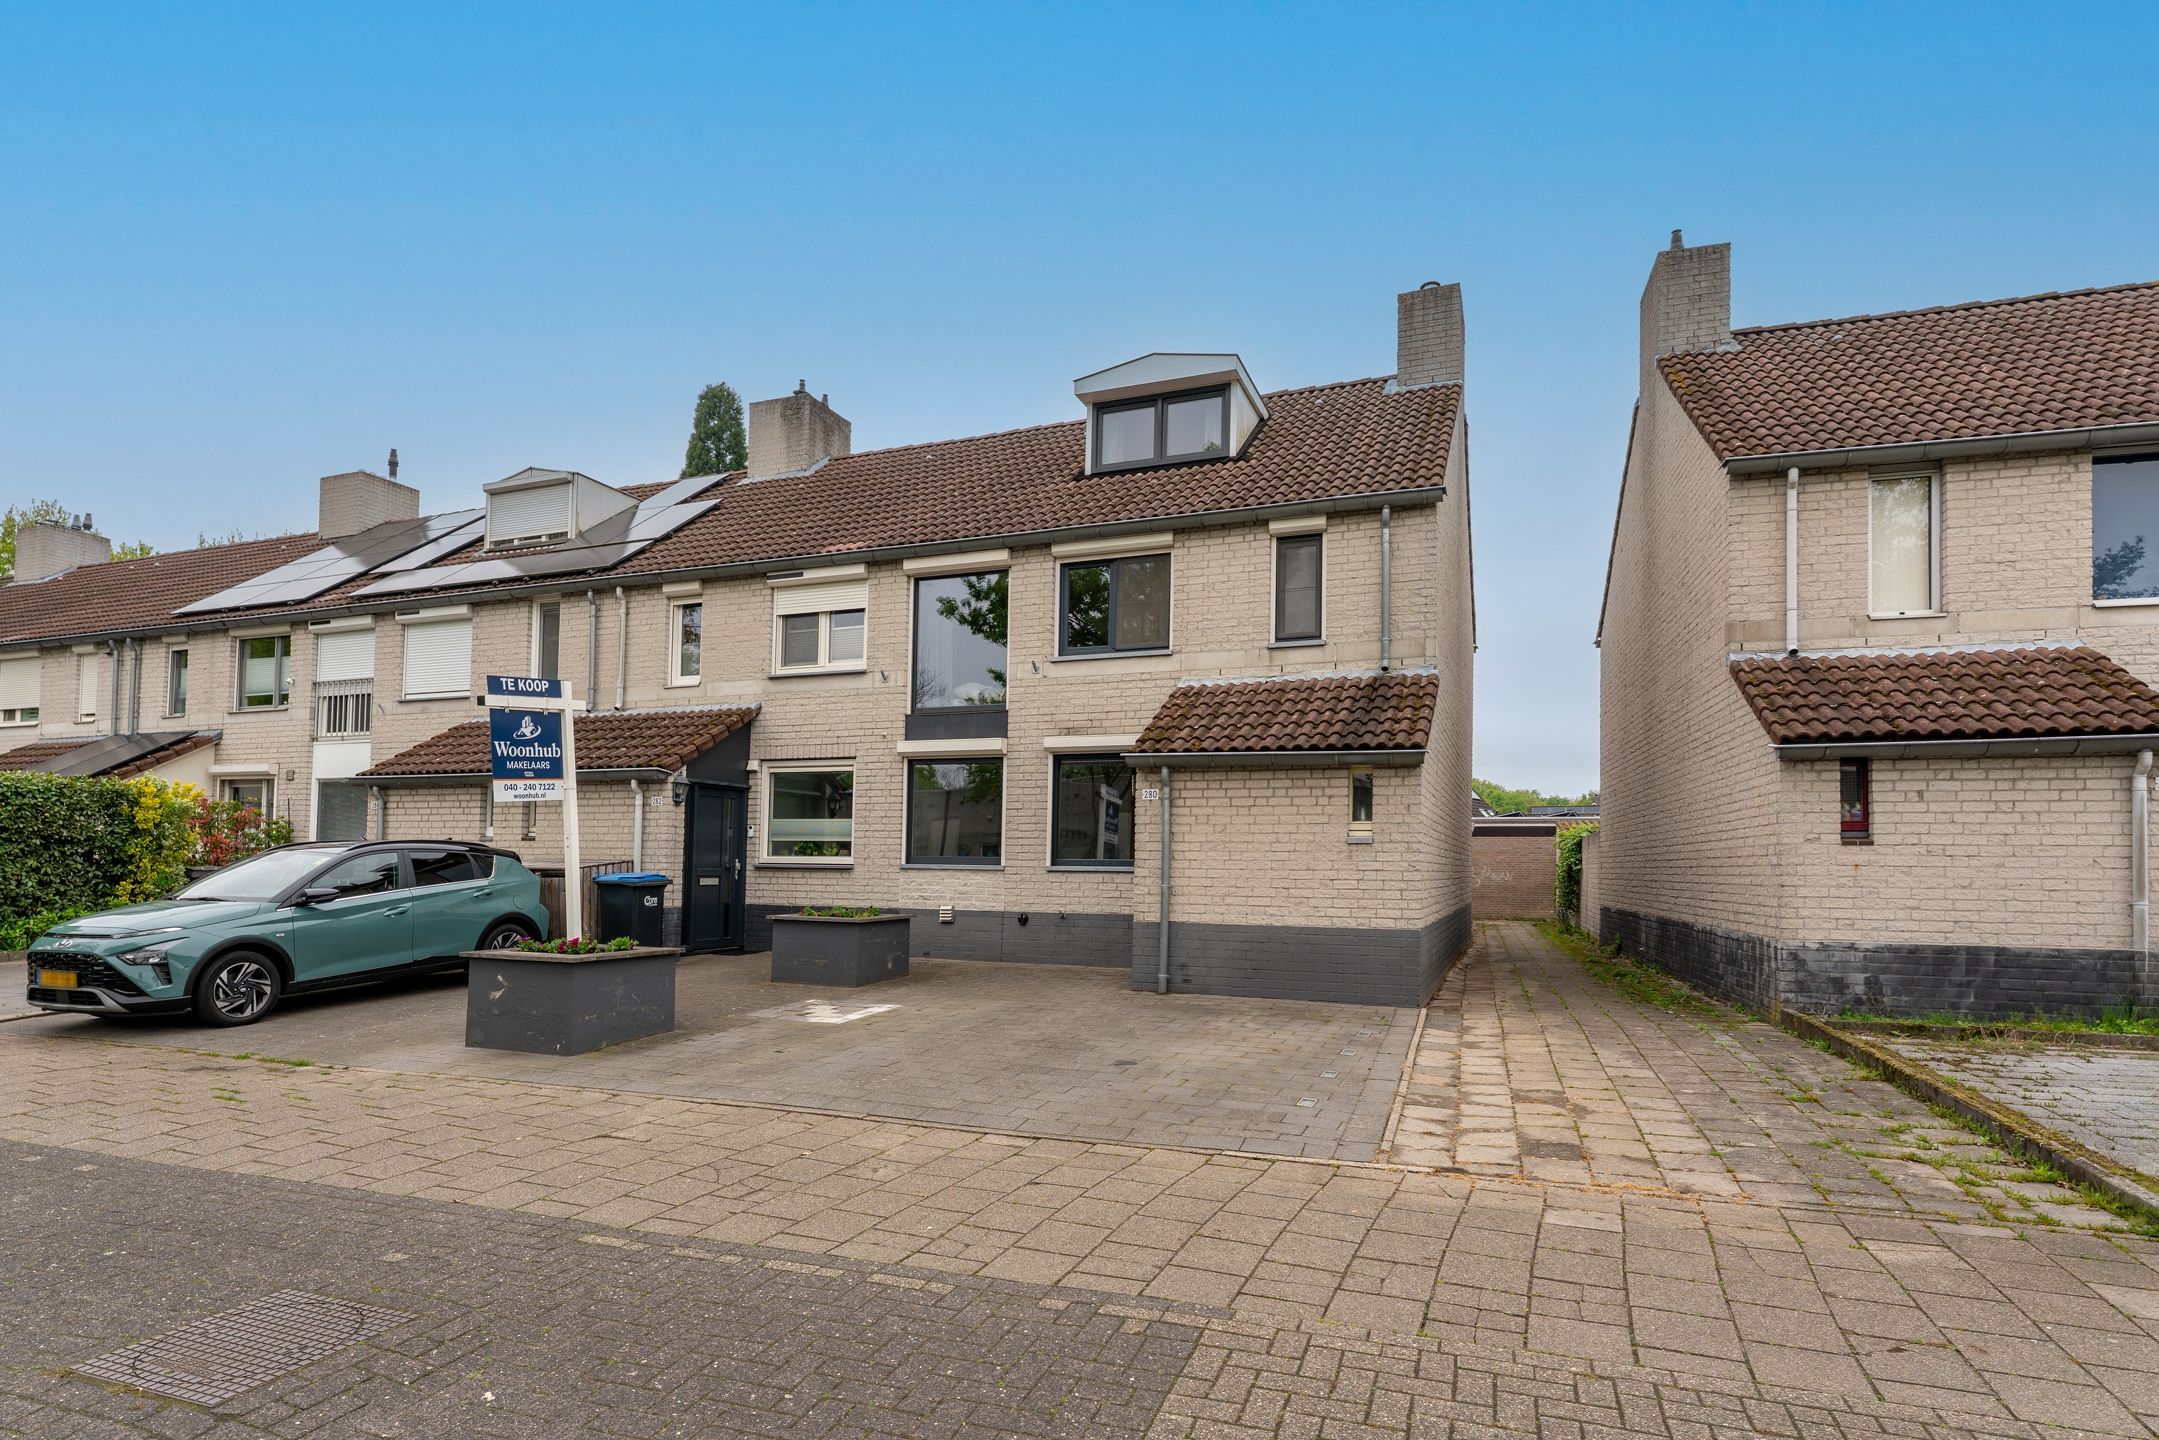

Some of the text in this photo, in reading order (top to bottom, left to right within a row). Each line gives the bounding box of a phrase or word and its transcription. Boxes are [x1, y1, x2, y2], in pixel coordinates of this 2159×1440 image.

[500, 677, 549, 693] TE KOOP
[493, 740, 561, 758] Woonhub
[506, 760, 551, 769] MAKELAARS
[503, 783, 518, 791] 040
[523, 783, 537, 791] 240
[538, 783, 556, 791] 7122
[1144, 790, 1158, 798] 280
